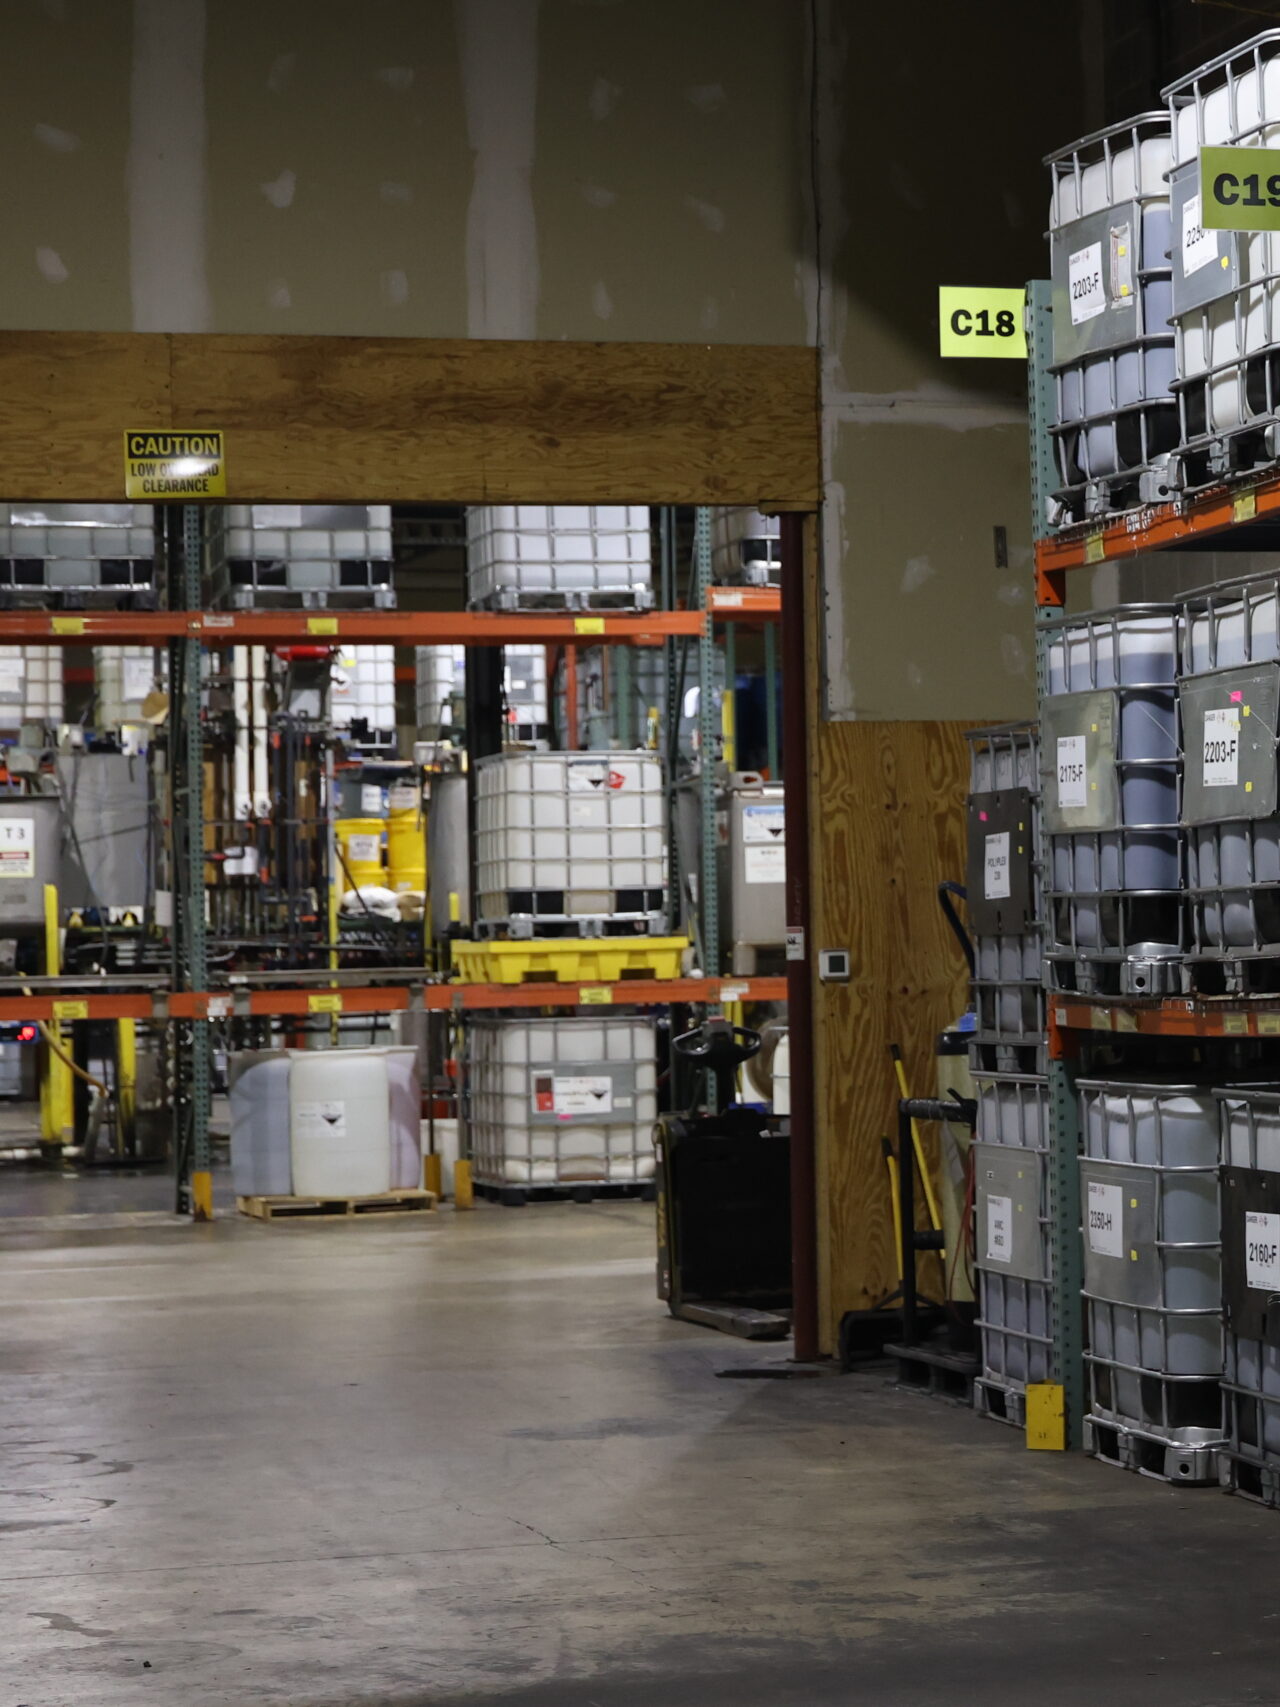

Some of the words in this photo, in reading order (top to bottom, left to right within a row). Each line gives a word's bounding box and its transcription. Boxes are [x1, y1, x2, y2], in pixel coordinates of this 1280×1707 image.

[1072, 272, 1099, 300] 2203-F
[951, 309, 1015, 337] C18
[131, 437, 218, 455] CAUTION
[131, 463, 156, 477] LOW
[143, 480, 209, 493] CLEARANCE
[1204, 740, 1236, 763] 2203-F
[1060, 765, 1083, 782] 2175-F
[1091, 1210, 1112, 1231] 2350-H
[1249, 1243, 1277, 1264] 2160-F
